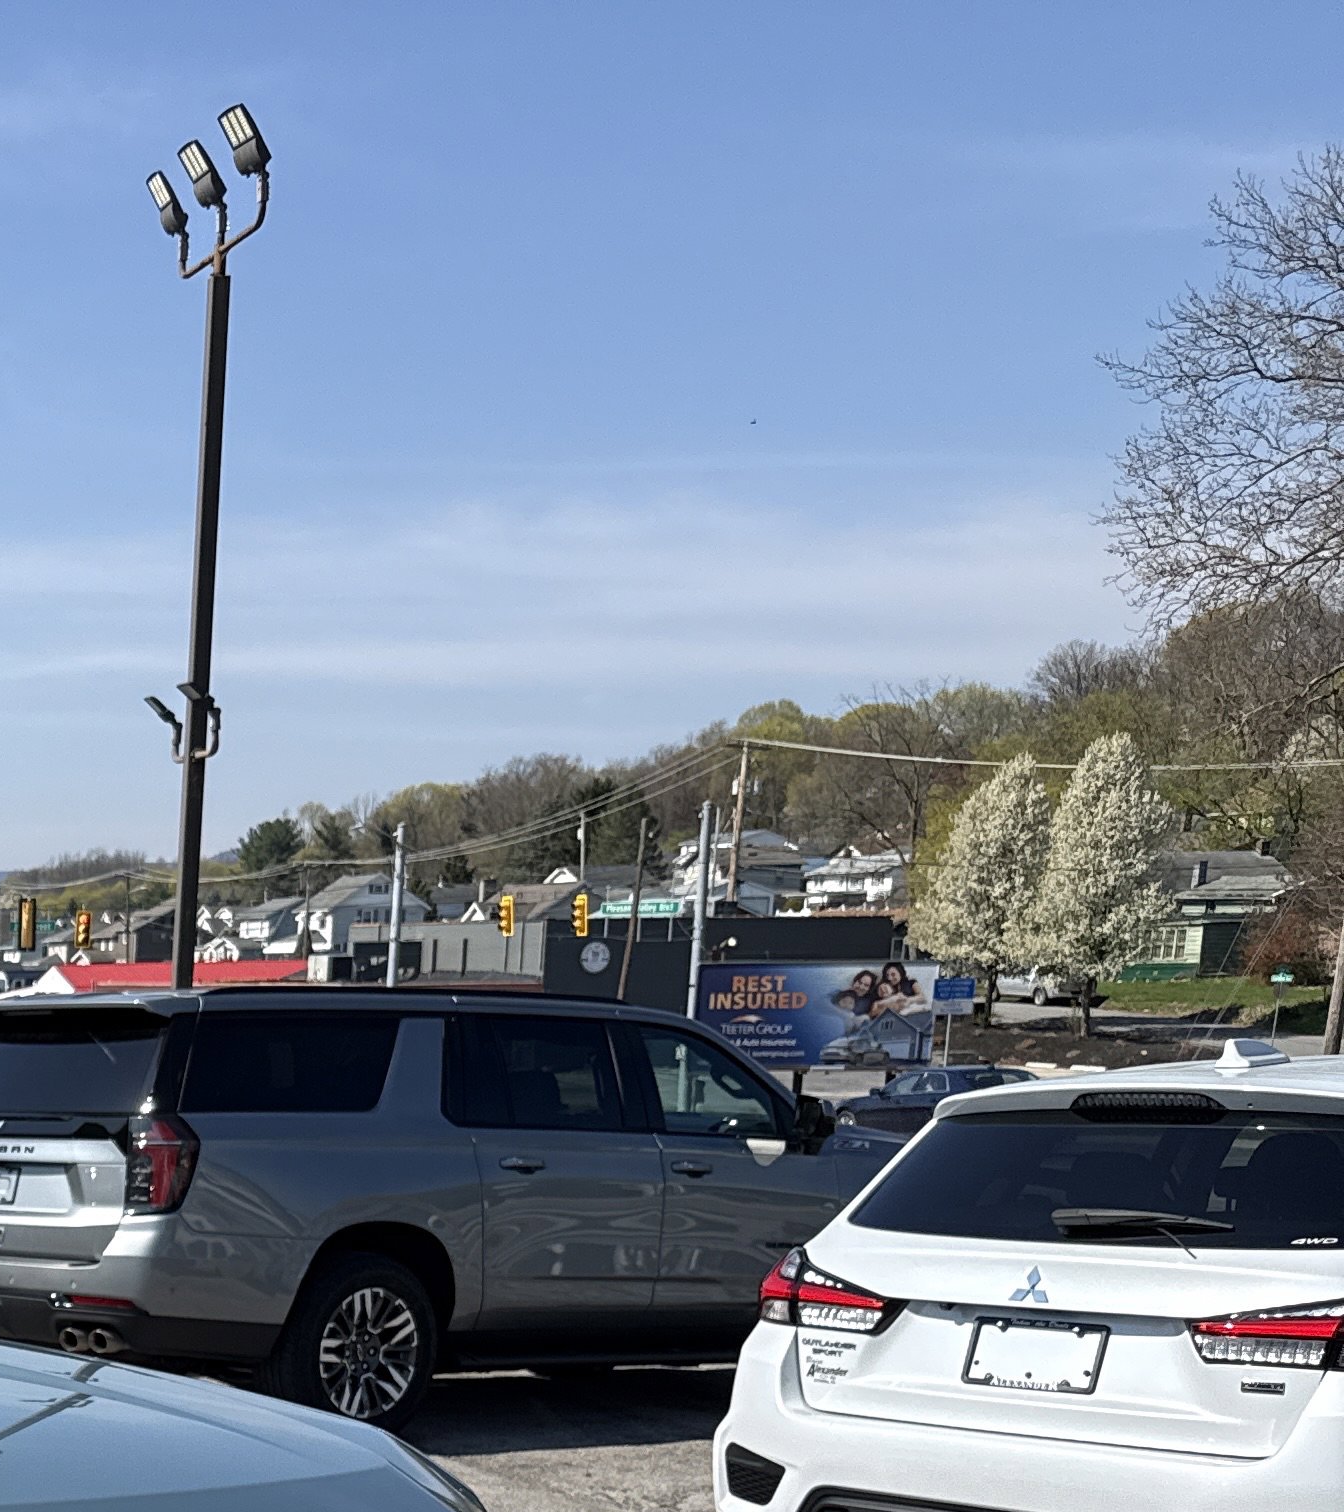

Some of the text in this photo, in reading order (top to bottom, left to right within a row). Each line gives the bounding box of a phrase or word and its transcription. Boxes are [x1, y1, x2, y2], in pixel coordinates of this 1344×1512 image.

[732, 975, 787, 992] REST
[708, 992, 809, 1010] INSURED
[1290, 1237, 1339, 1245] 4WD
